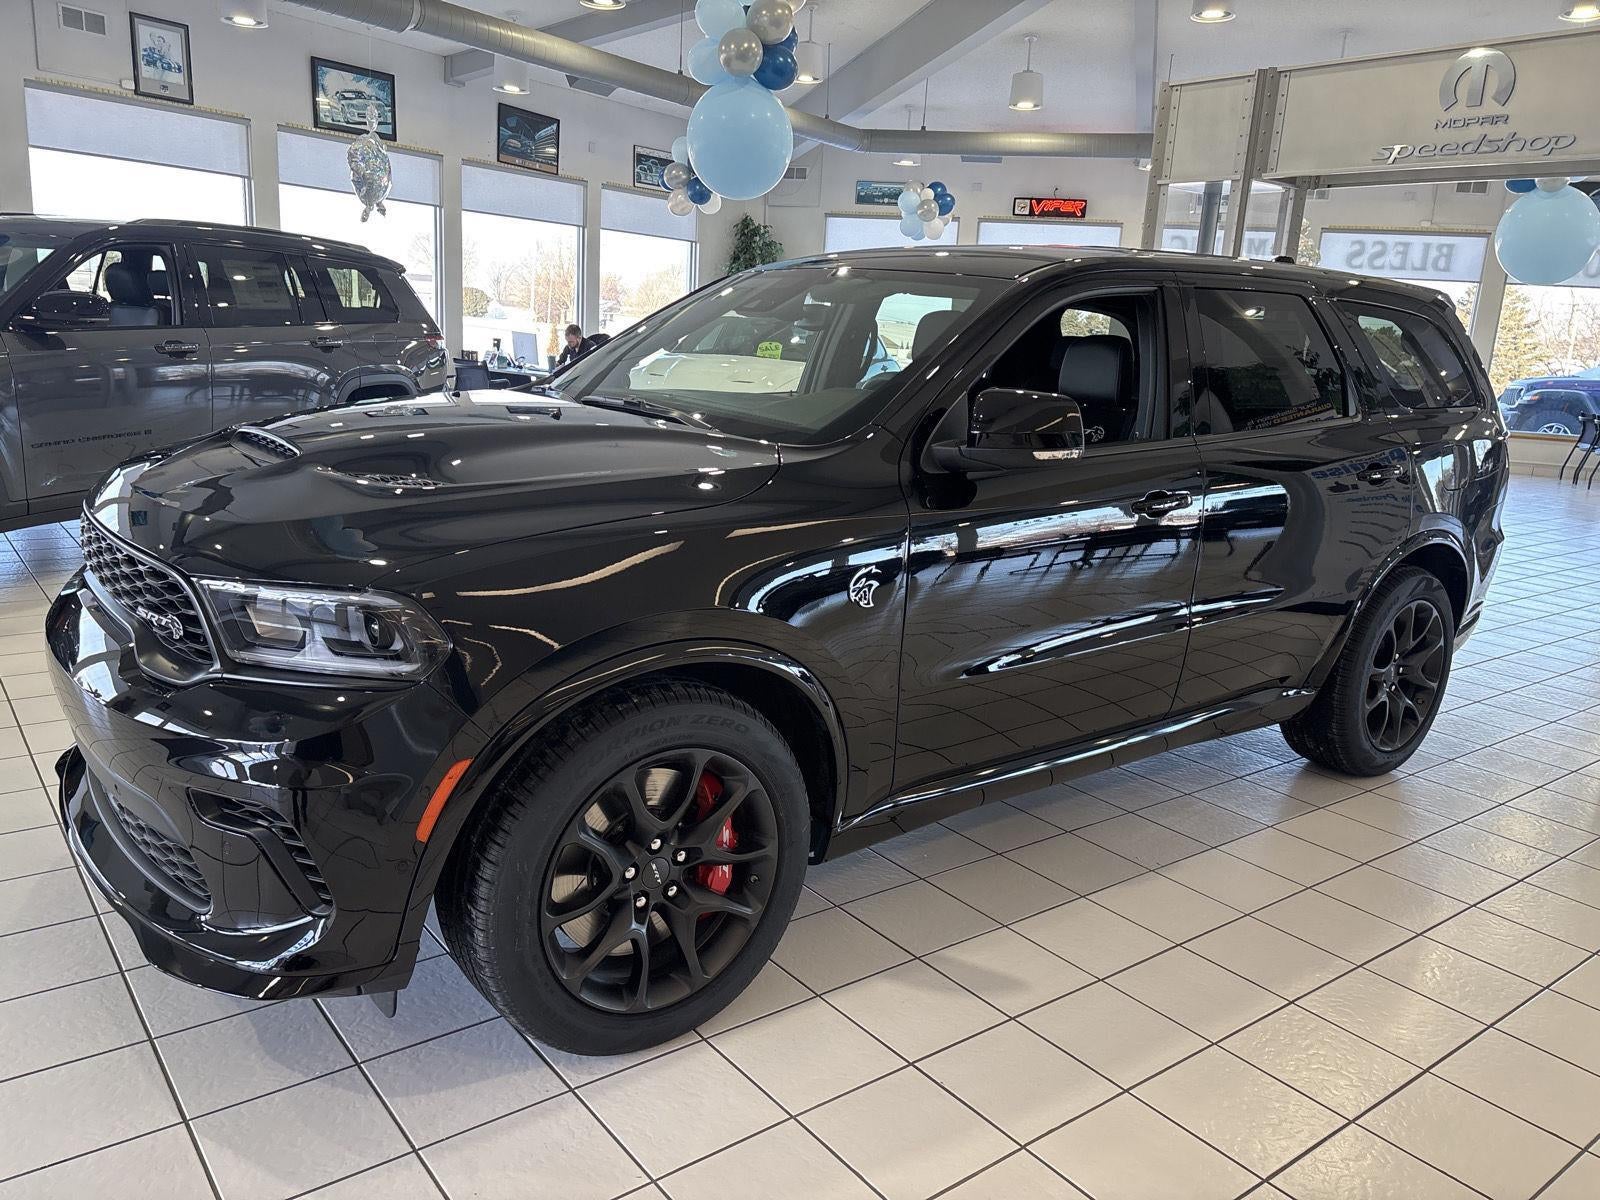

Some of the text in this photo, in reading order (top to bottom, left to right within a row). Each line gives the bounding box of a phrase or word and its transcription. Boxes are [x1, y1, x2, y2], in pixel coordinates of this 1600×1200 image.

[1434, 114, 1509, 131] MOPAR
[1371, 132, 1577, 164] speedshop
[1031, 199, 1086, 217] VIPER
[136, 605, 171, 627] SRT
[690, 713, 750, 734] ZERO
[650, 862, 663, 885] SRT
